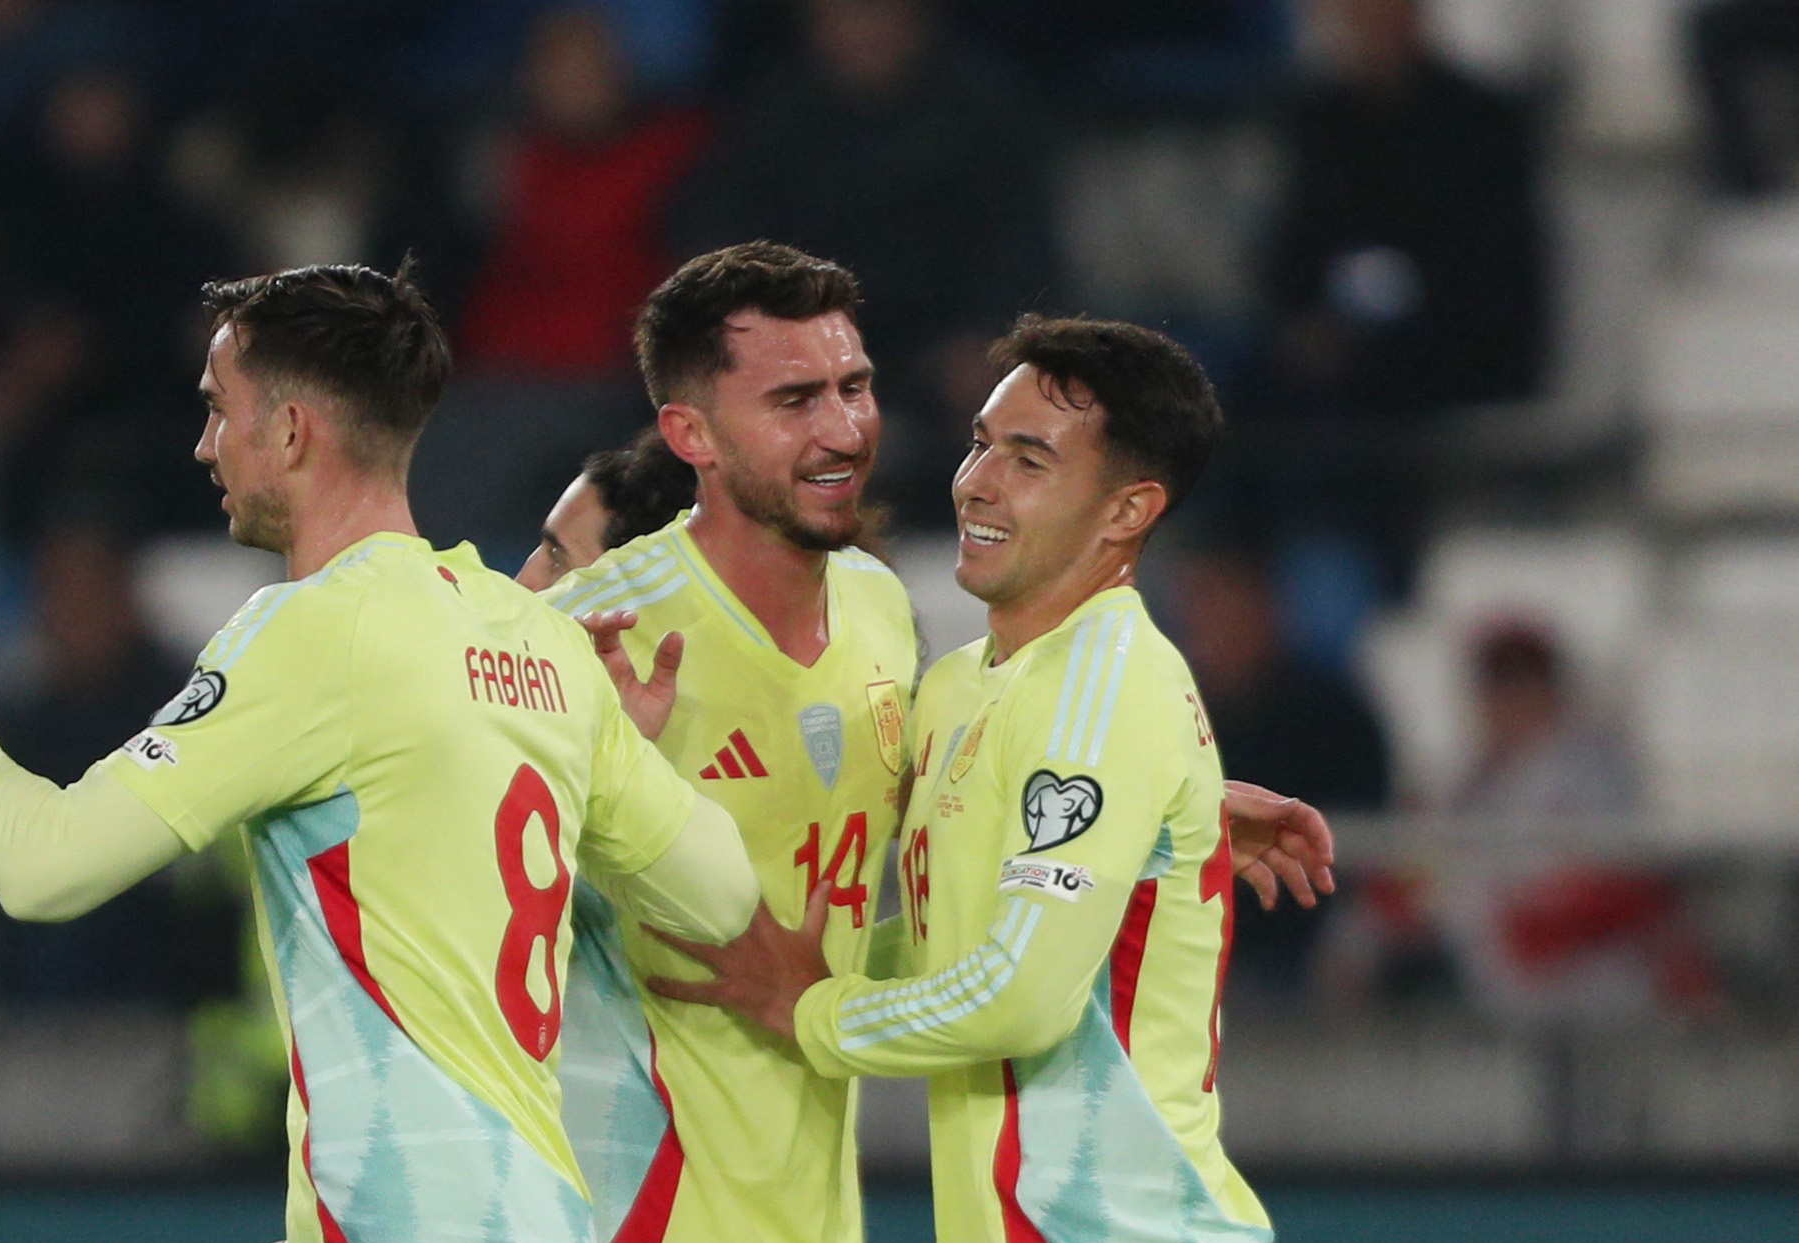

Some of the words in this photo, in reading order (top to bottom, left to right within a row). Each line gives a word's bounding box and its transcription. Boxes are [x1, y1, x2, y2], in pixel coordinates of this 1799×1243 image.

[466, 640, 569, 714] FABIÁN
[495, 763, 571, 1062] 8
[794, 811, 868, 929] 14
[902, 824, 930, 947] 18
